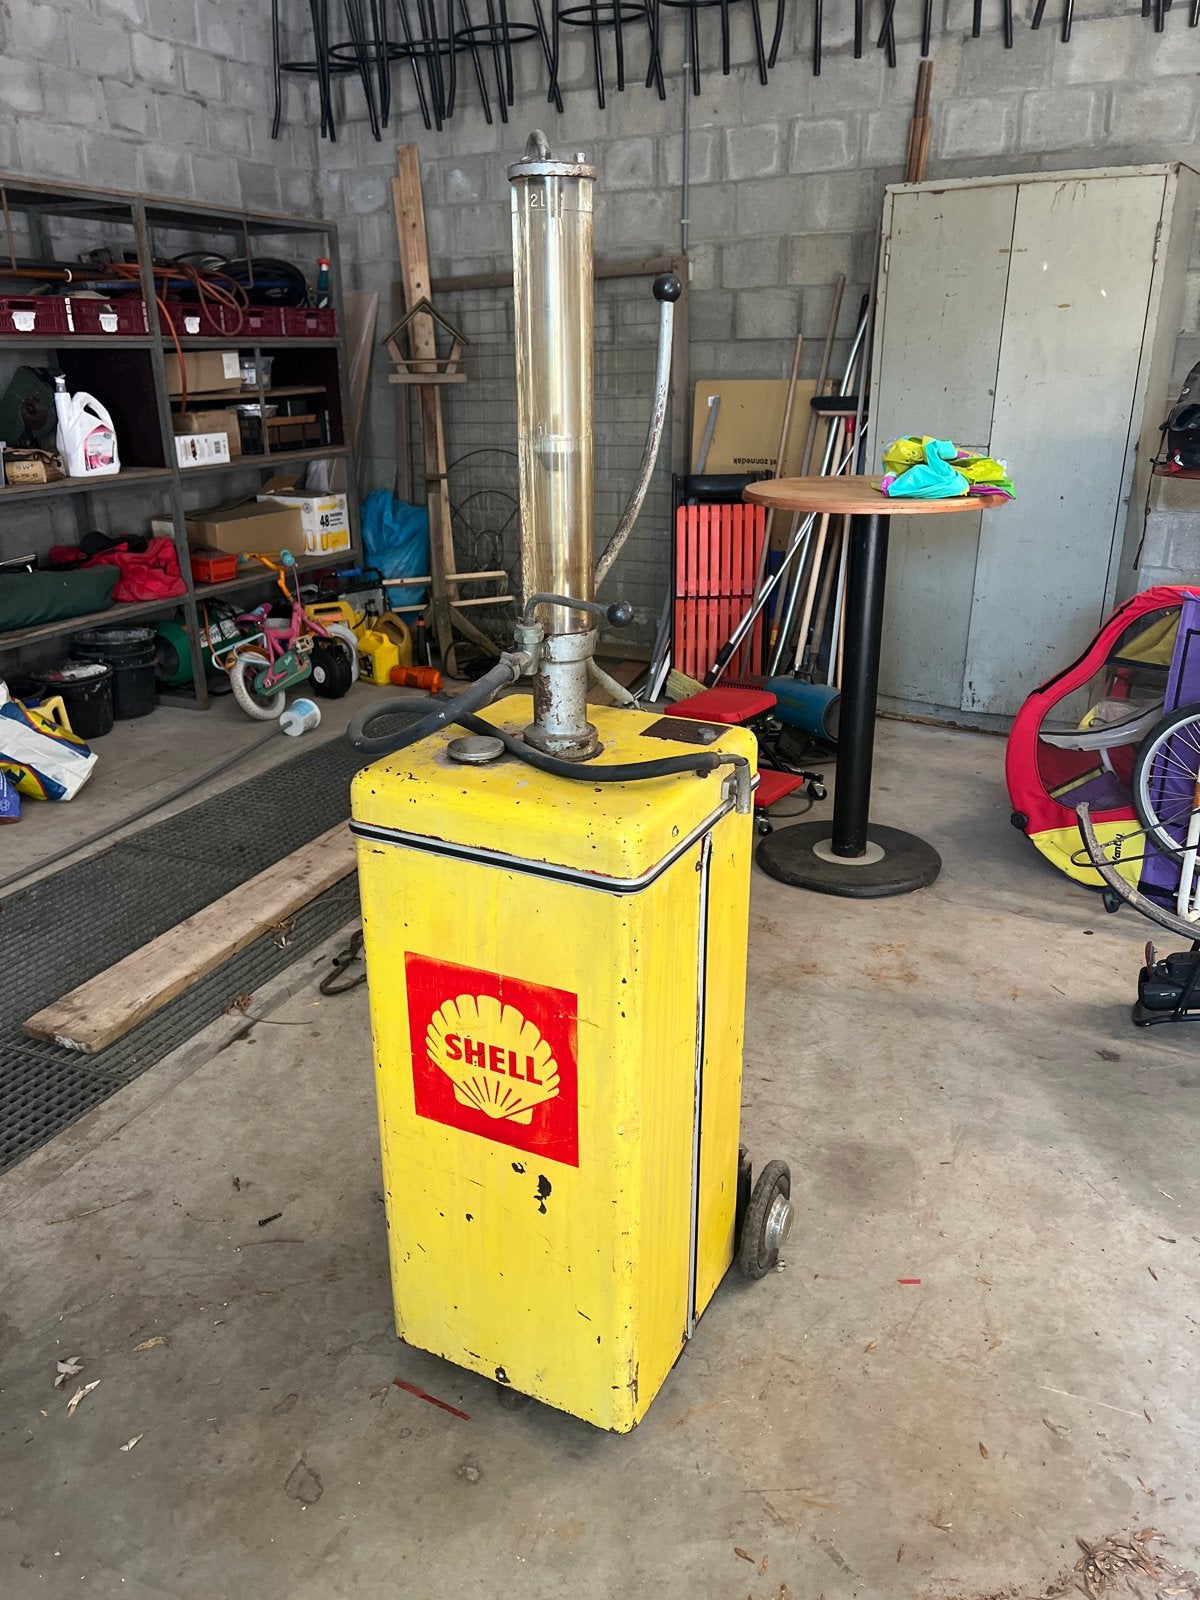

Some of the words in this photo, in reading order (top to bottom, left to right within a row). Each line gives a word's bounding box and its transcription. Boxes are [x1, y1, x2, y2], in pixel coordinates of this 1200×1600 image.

[733, 457, 769, 466] zonnedak
[320, 514, 330, 527] 48
[444, 1033, 543, 1086] SHELL
